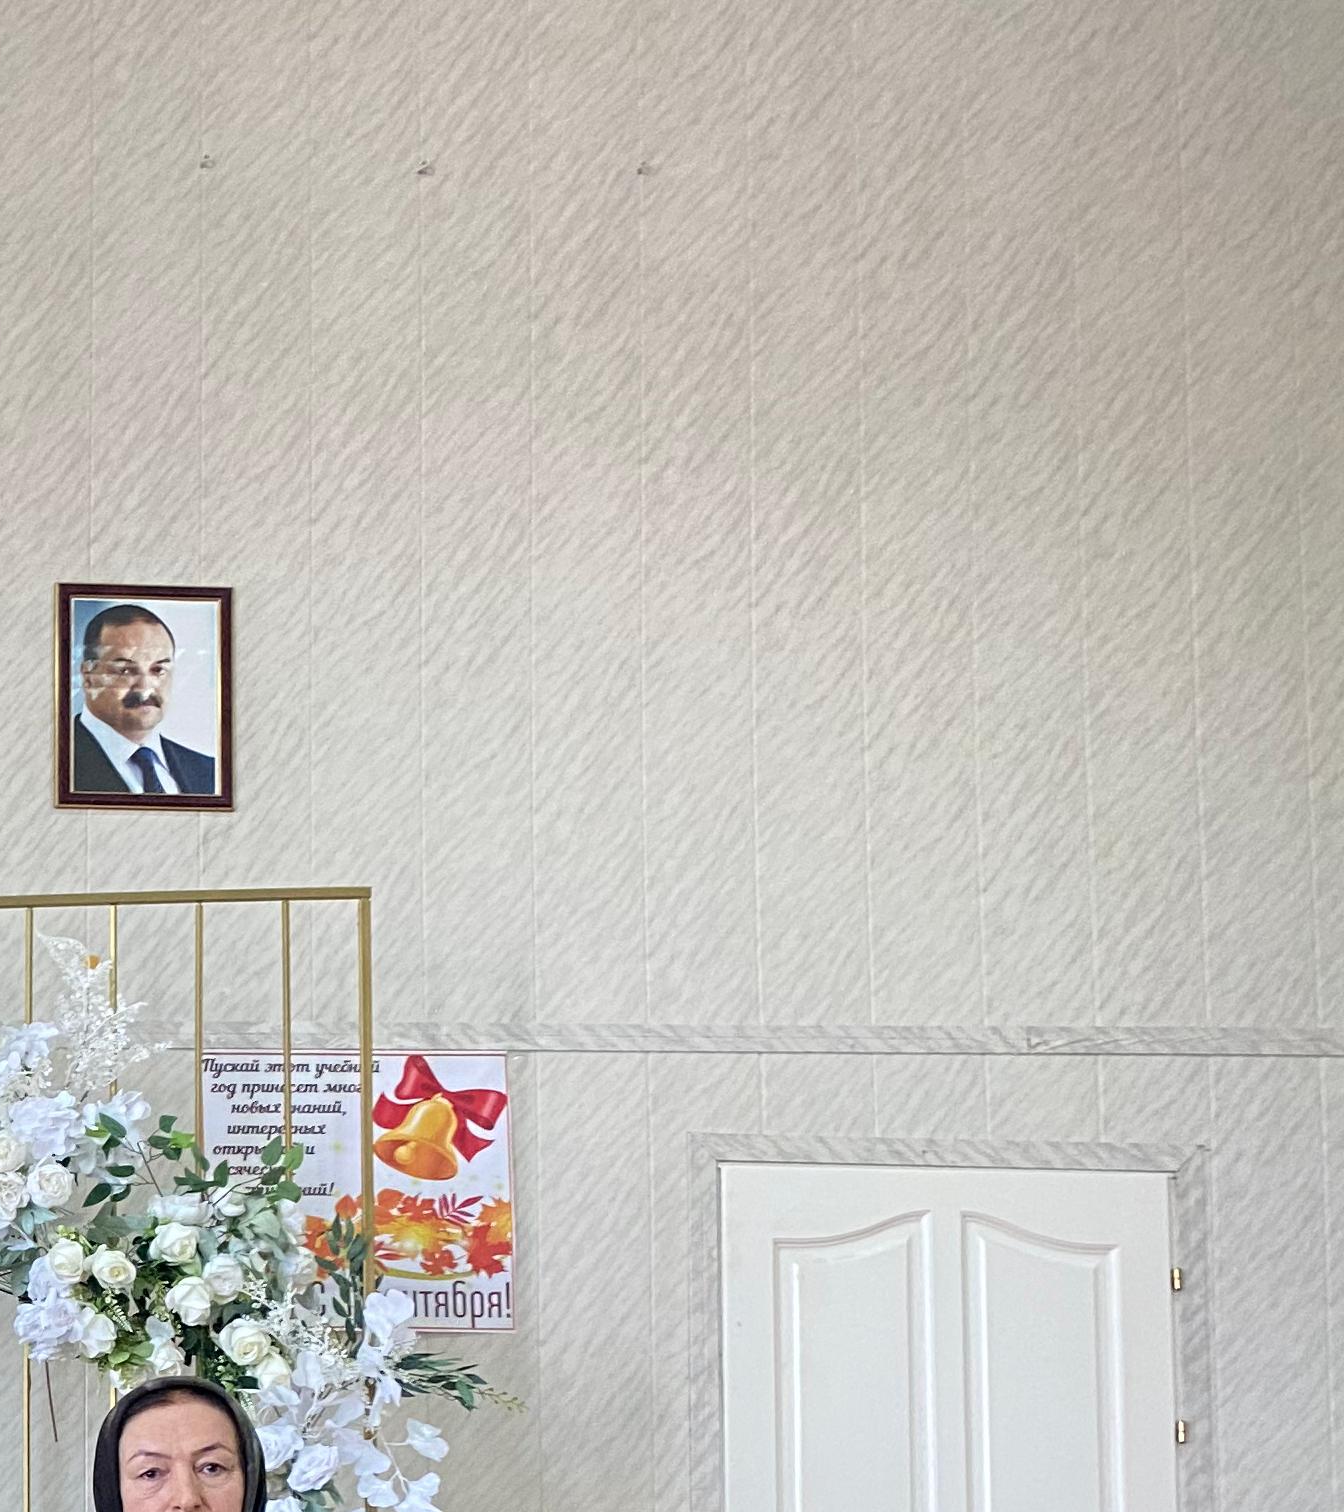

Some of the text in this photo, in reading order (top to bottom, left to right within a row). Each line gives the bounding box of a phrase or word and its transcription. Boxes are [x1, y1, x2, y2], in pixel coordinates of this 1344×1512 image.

[201, 1058, 261, 1079] Пускай
[315, 1059, 380, 1079] учебнй
[210, 1082, 237, 1099] год
[323, 1083, 363, 1093] мног
[230, 1100, 347, 1117] новых наний,
[227, 1123, 327, 1141] интереных
